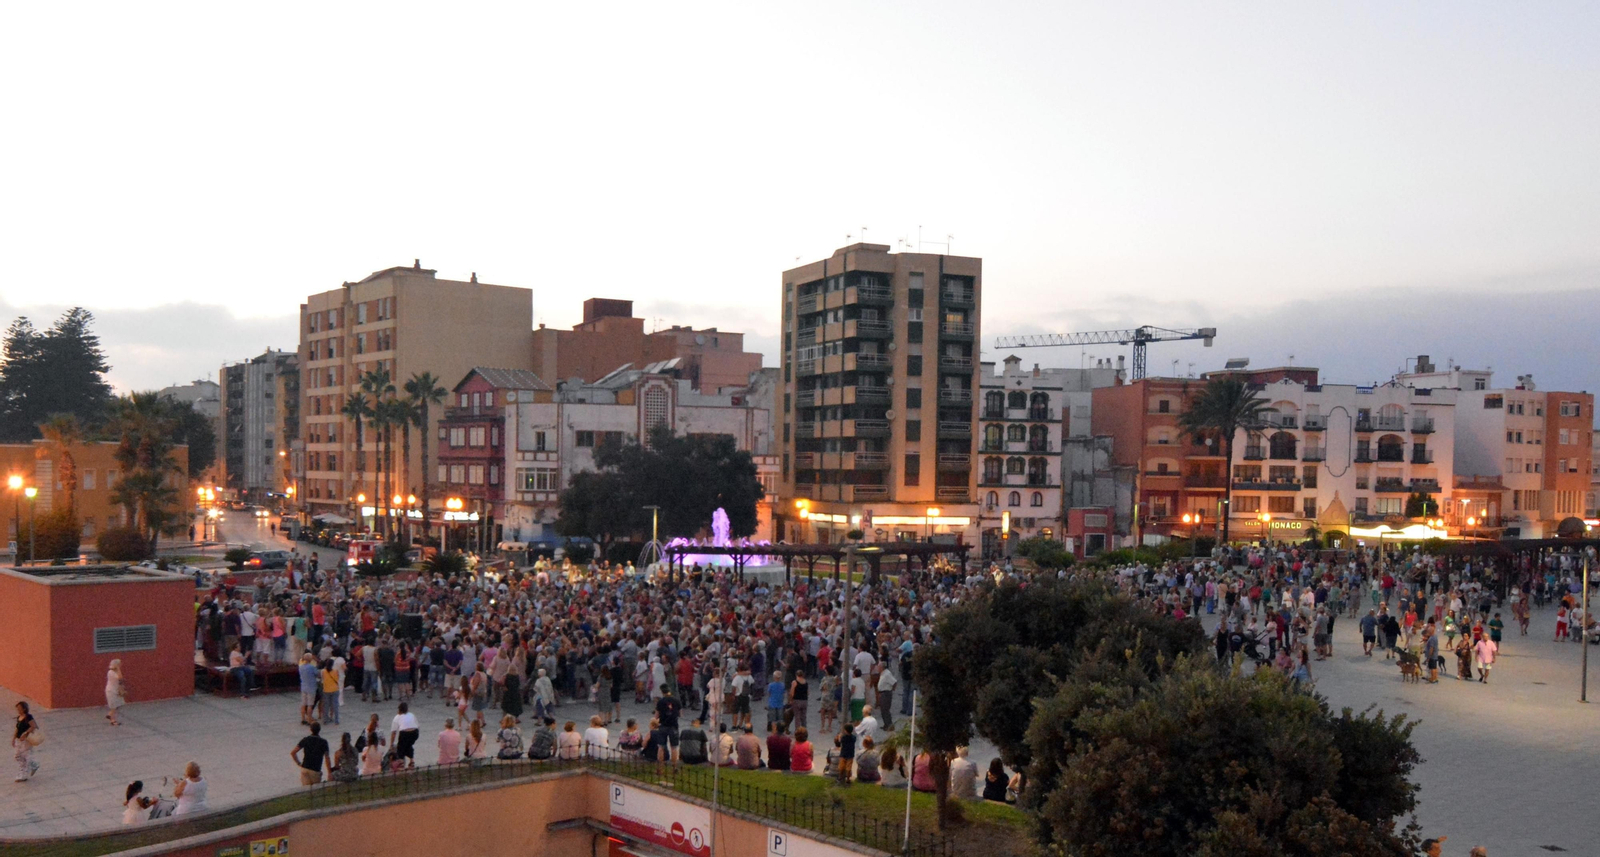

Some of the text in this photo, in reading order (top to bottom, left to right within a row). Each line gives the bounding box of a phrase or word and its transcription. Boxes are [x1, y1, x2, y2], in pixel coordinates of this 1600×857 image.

[1268, 521, 1302, 529] MONACO
[615, 787, 621, 800] P
[774, 834, 782, 850] P
